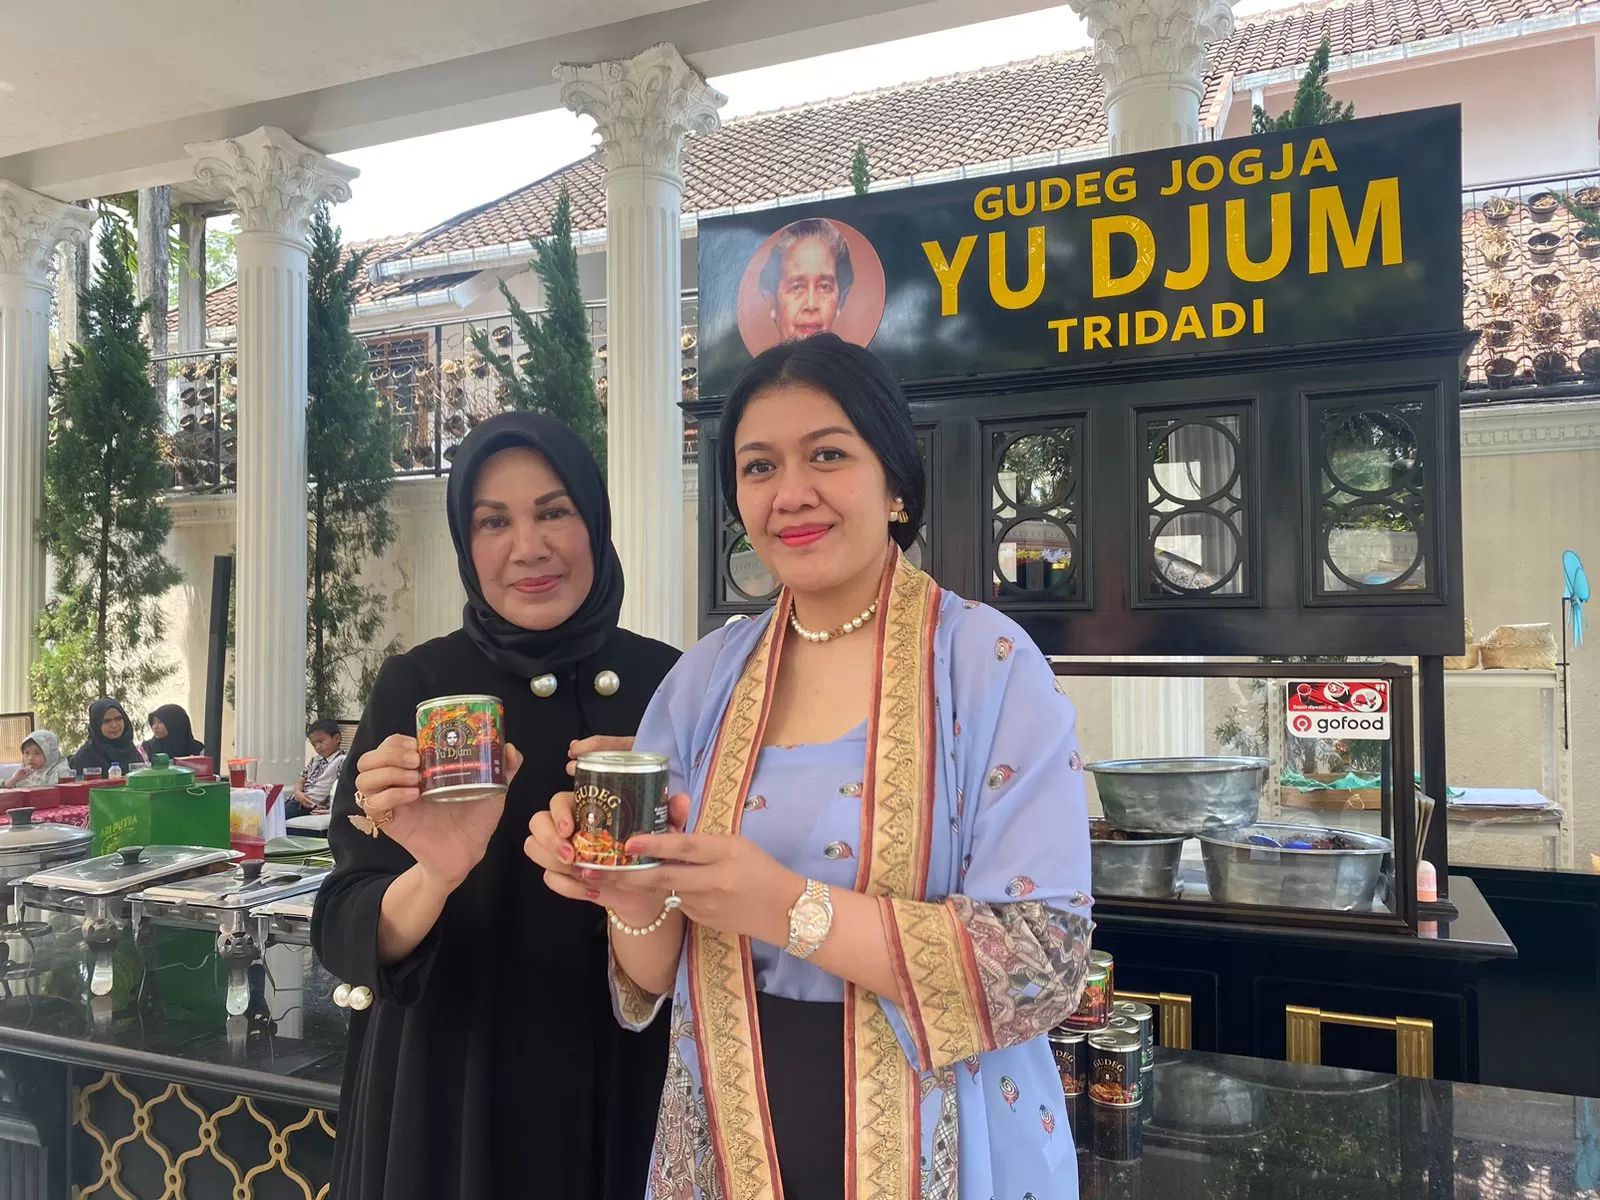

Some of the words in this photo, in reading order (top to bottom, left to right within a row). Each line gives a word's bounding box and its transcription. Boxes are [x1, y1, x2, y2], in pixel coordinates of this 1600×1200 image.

[973, 167, 1138, 222] GUDEG
[1159, 137, 1339, 198] JOGJA
[921, 224, 1047, 318] YU
[1091, 176, 1405, 300] DJUM
[1047, 298, 1265, 354] TRIDADI
[1317, 715, 1384, 734] gofood
[447, 746, 472, 760] Djum
[575, 785, 622, 809] GUDEG
[1093, 1057, 1126, 1073] GUDEG
